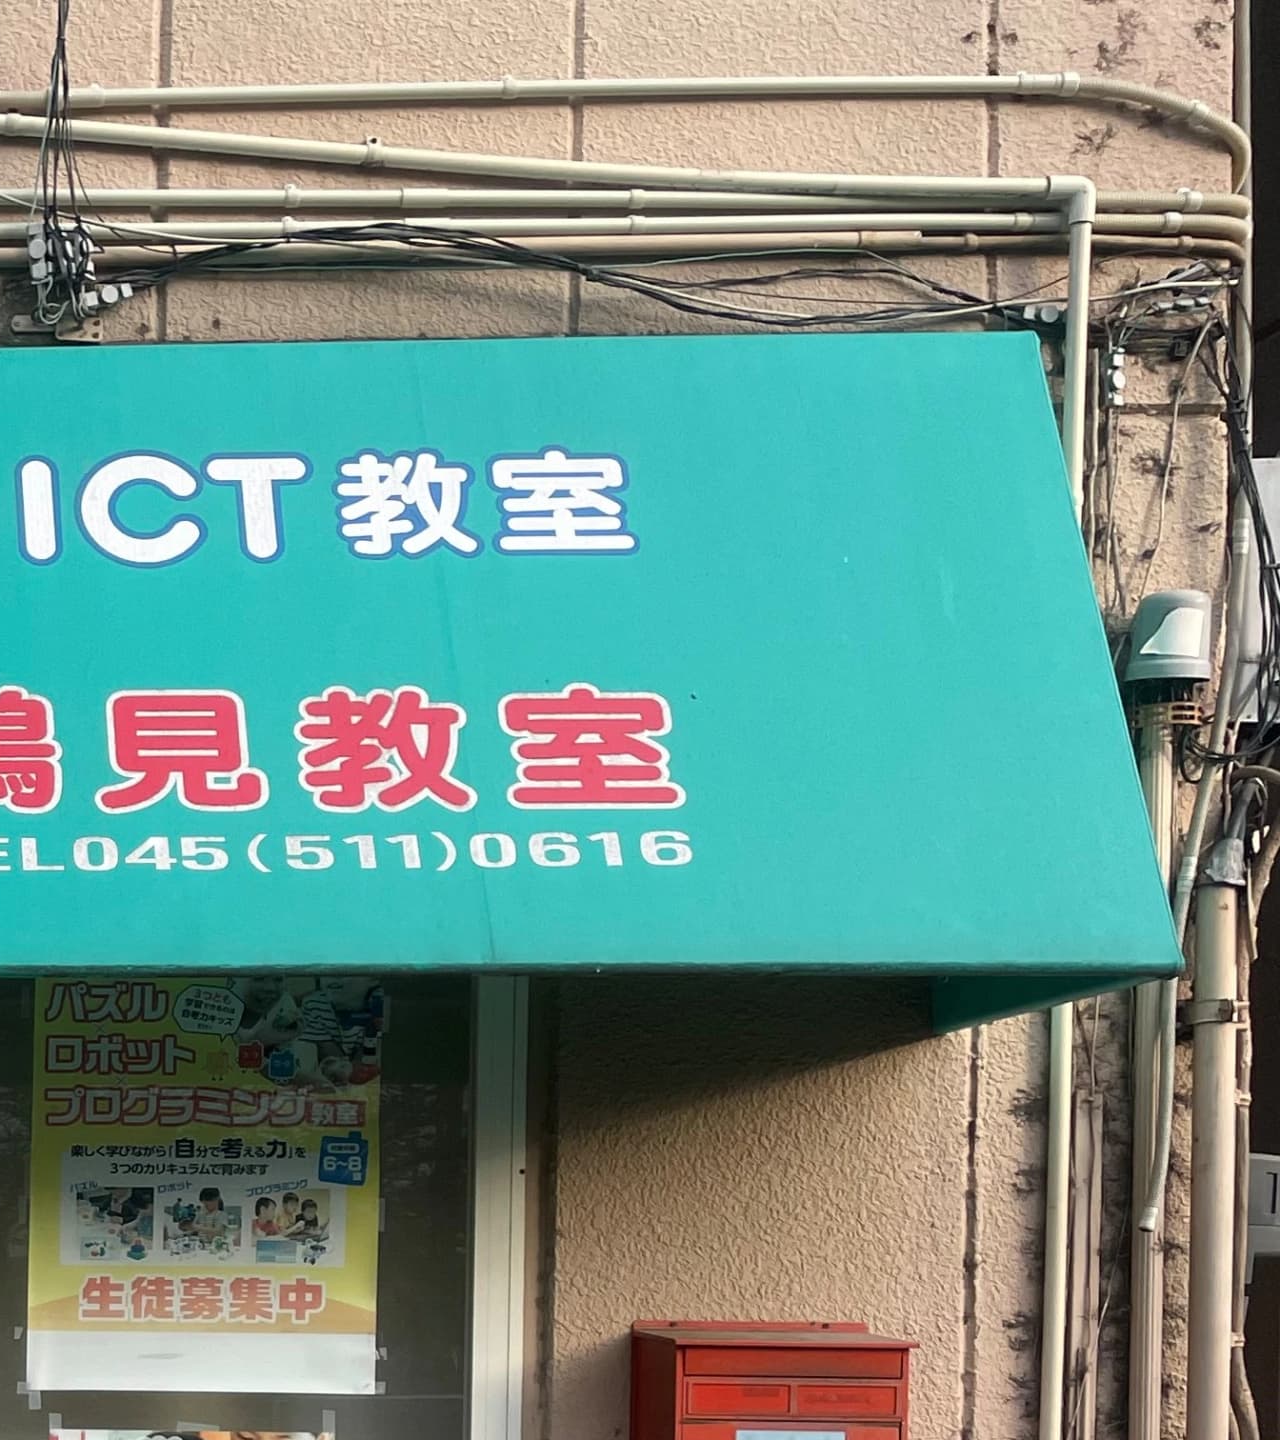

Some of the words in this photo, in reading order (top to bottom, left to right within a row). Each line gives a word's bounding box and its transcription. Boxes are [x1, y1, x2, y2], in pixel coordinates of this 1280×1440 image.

[45, 982, 169, 1024] パズル
[45, 1035, 196, 1075] ロボット
[45, 1085, 366, 1129] プログラミング教室
[108, 1162, 270, 1177] 3つのカリキュラムで育みます
[156, 1181, 193, 1194] ロボット
[245, 1179, 309, 1198] プログラミング
[79, 1273, 327, 1324] 生徒募集中
